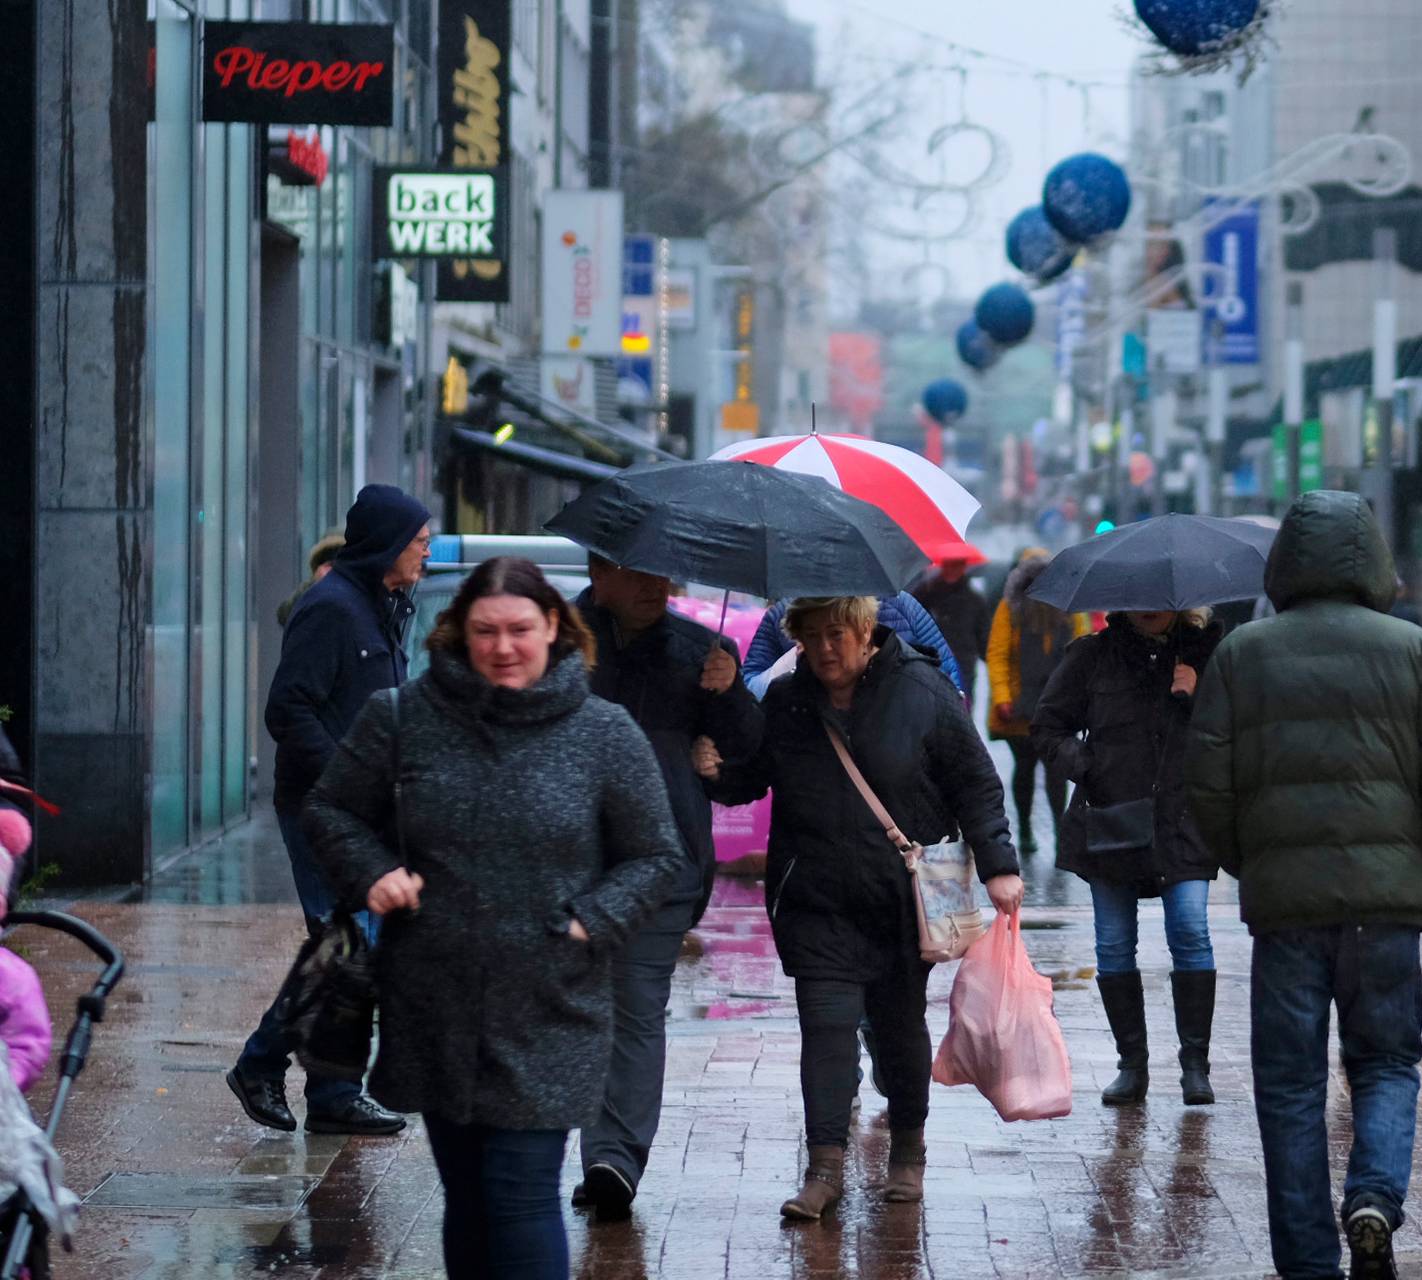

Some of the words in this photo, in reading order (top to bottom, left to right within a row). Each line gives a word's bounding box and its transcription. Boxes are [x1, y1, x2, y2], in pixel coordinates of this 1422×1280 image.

[213, 46, 385, 98] Pieper
[397, 180, 486, 212] back
[389, 220, 495, 254] WERK
